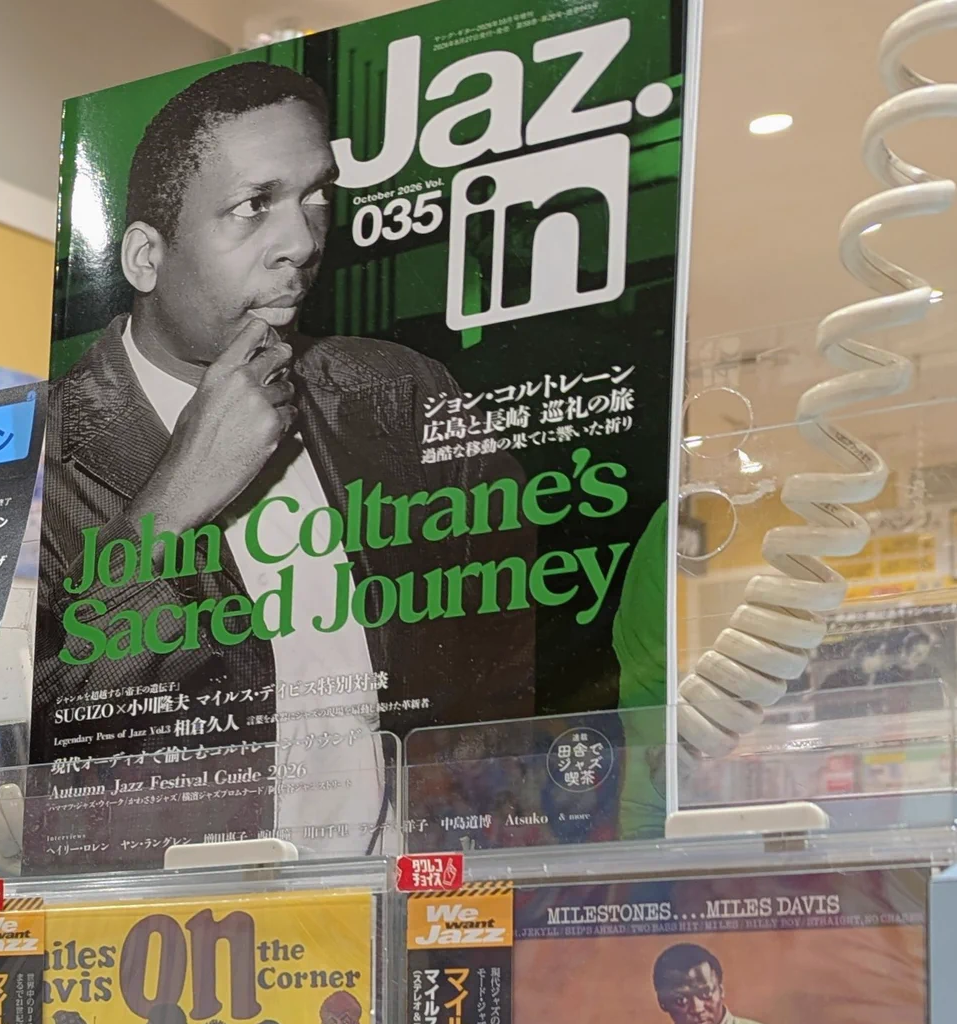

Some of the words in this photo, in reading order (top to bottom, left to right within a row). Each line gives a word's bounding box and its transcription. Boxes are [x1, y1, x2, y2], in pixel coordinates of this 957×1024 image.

[330, 17, 673, 189] Jaz.
[352, 190, 395, 206] October
[397, 182, 423, 198] 2026
[424, 177, 445, 191] Vol.
[351, 190, 443, 247] 035
[423, 364, 636, 420] ジョン・コルトレーン
[421, 404, 531, 445] 広島と長崎
[539, 386, 635, 424] 巡礼の旅
[63, 513, 222, 595] John
[244, 447, 629, 565] Coltrane's
[59, 565, 297, 666] Sacred
[312, 542, 631, 635] Journey
[54, 735, 94, 748] Legendary
[96, 731, 115, 741] Pens
[117, 730, 128, 739] of
[51, 784, 105, 800] Autumn
[150, 771, 208, 791] Festival
[214, 768, 261, 786] Guide
[267, 763, 308, 780] 2026
[504, 812, 550, 827] Atsuko
[426, 905, 479, 923] We
[777, 895, 841, 916] DAVIS
[415, 925, 505, 945] Jazz
[445, 918, 496, 930] want
[43, 939, 117, 971] iles
[257, 940, 305, 961] the
[258, 968, 361, 990] Corner
